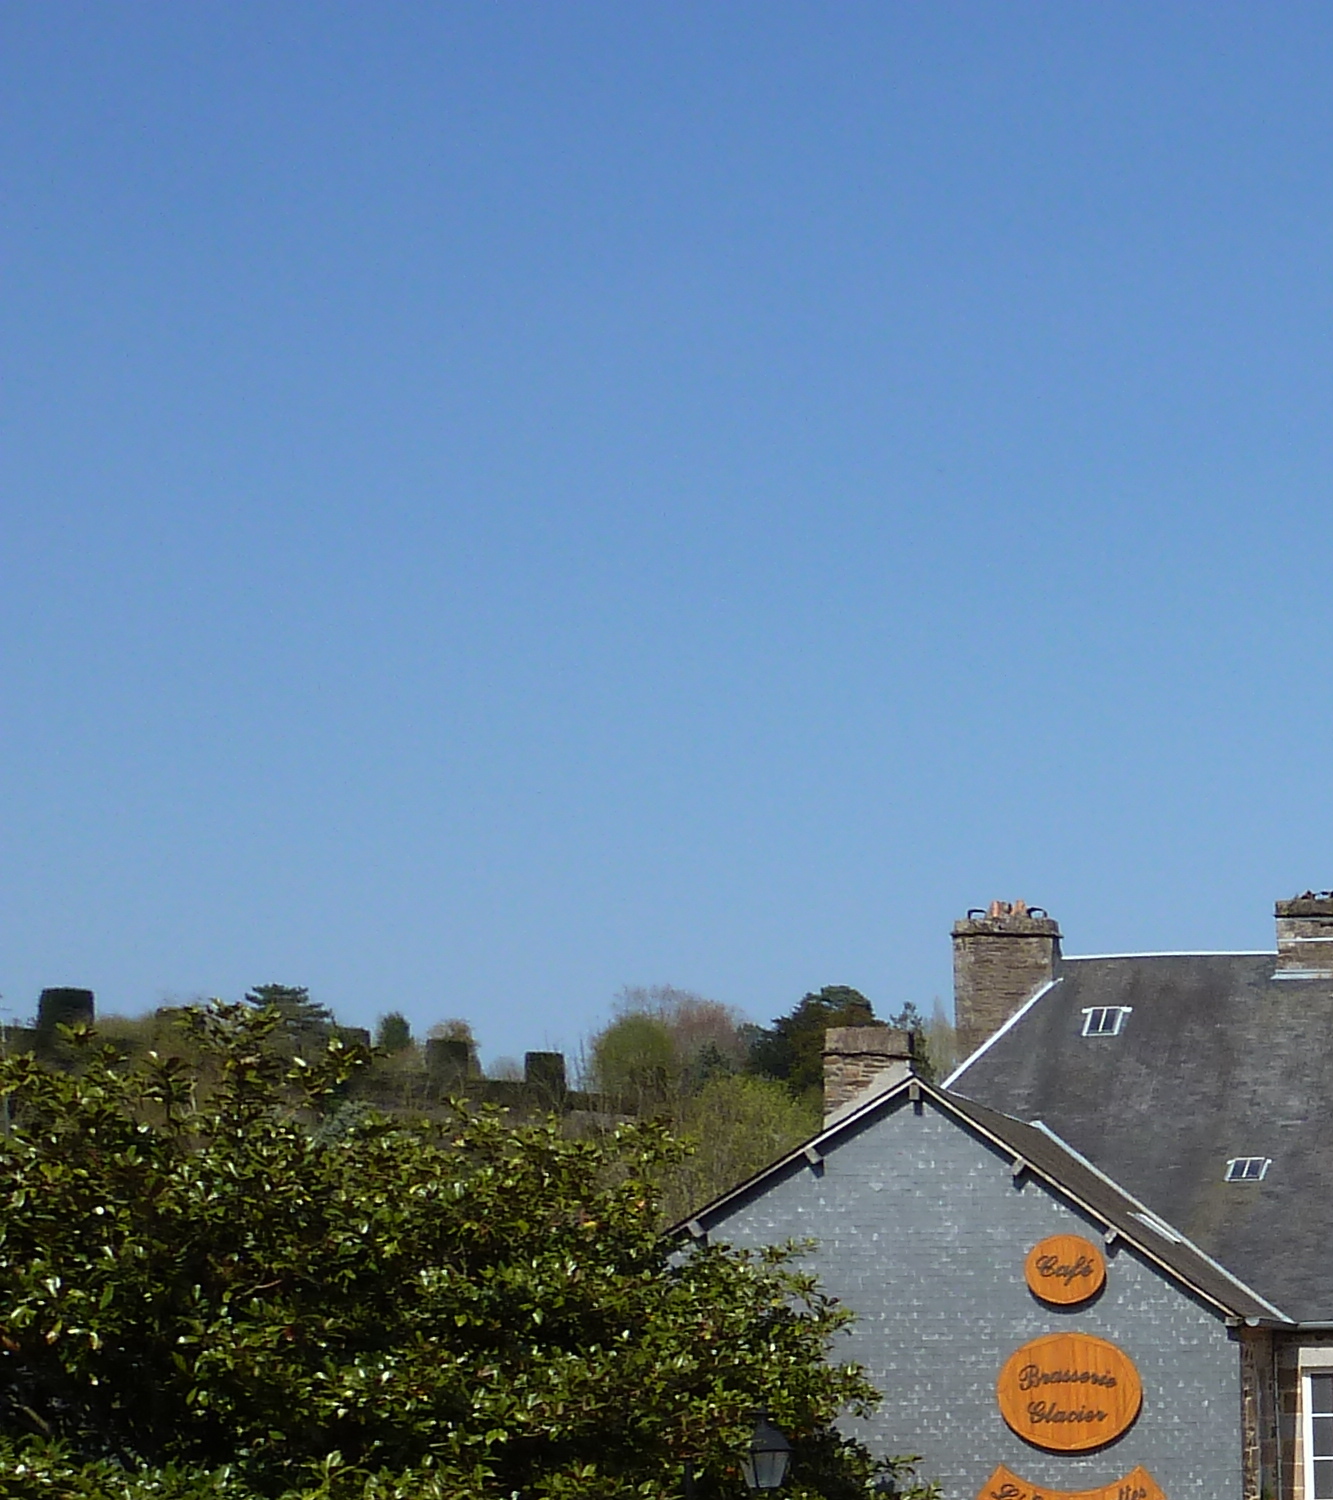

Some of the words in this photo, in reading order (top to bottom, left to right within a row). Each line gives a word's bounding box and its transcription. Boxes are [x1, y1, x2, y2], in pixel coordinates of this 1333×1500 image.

[1035, 1255, 1095, 1286] Café
[1018, 1364, 1118, 1391] Brasserie
[1027, 1400, 1108, 1424] Glacier
